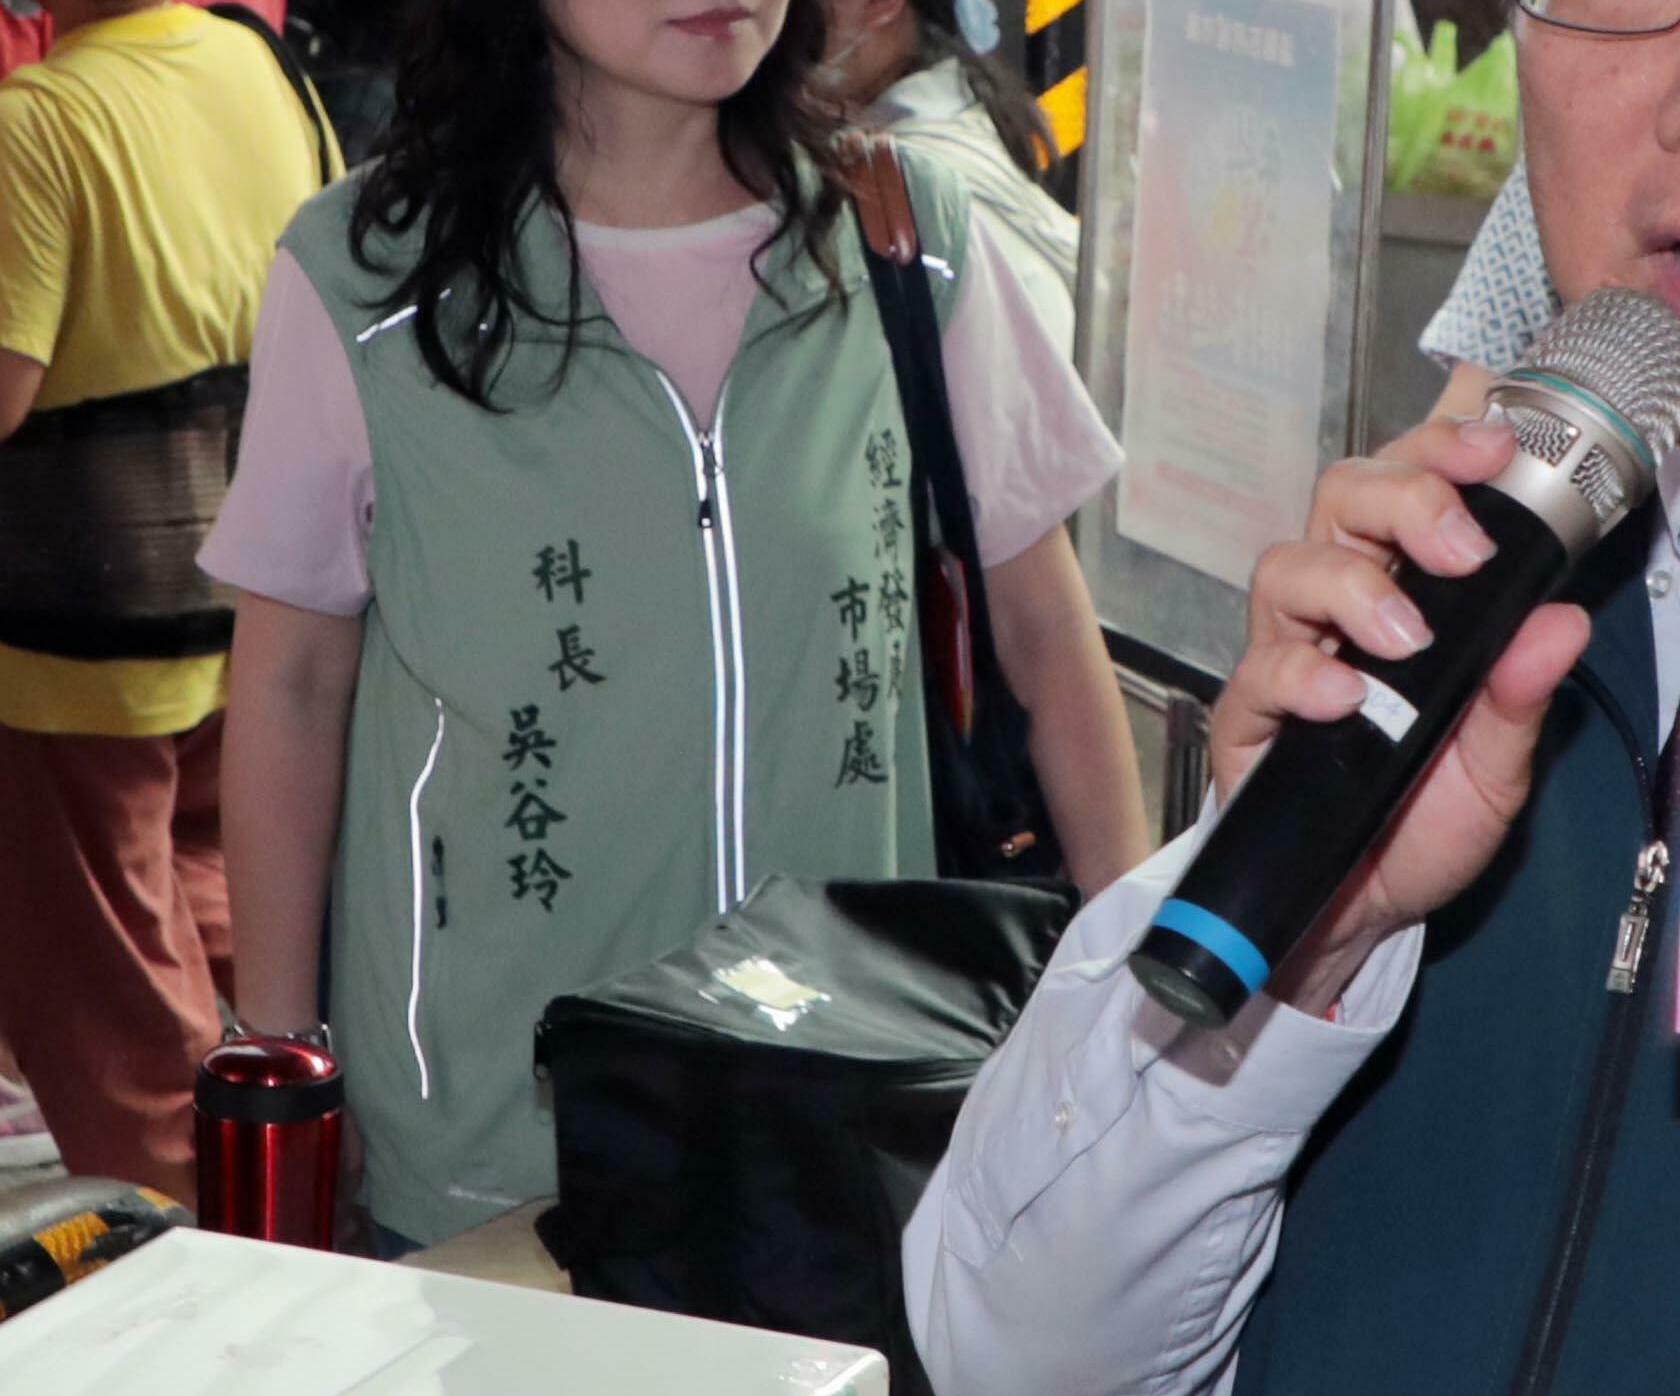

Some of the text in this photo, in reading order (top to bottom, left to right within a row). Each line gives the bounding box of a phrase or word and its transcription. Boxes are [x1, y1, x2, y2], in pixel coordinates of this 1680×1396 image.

[532, 539, 607, 693] 科長
[831, 575, 888, 788] 市場處
[501, 702, 573, 912] 吳谷玲
